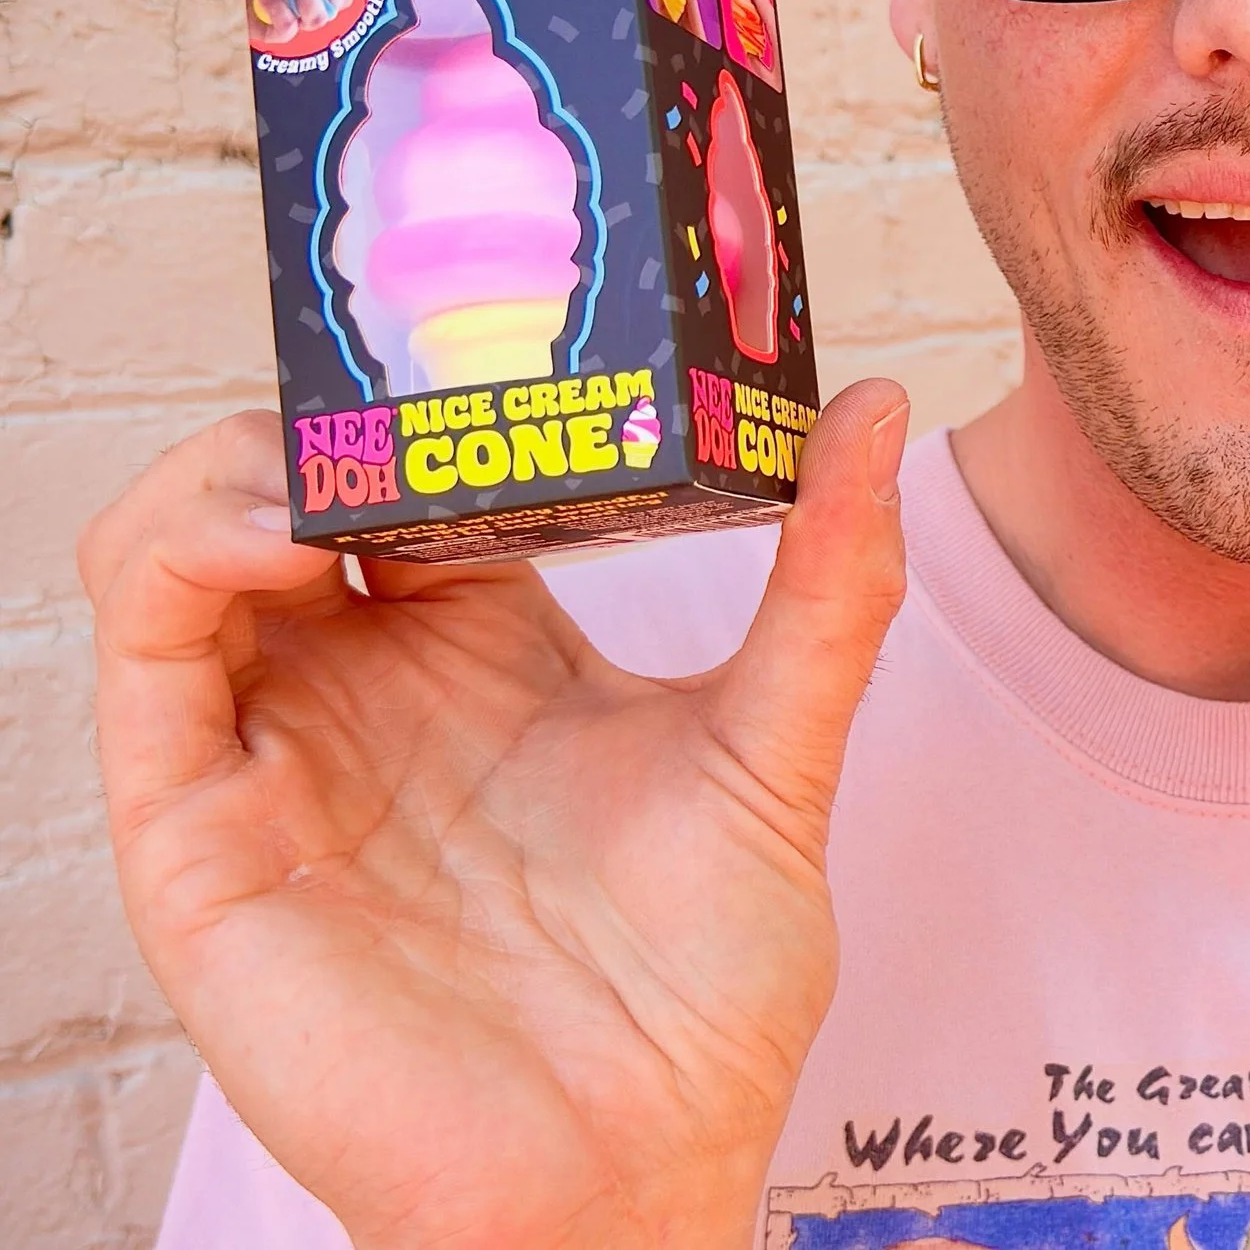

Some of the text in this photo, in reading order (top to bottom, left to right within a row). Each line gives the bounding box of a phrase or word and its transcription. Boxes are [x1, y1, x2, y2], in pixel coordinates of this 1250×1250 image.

[257, 51, 330, 74] Creamy
[400, 369, 655, 437] NICE CREAM
[689, 367, 734, 431] NEE
[734, 382, 771, 422] NICE
[294, 407, 393, 465] NEE
[405, 413, 619, 494] CONE
[694, 408, 737, 470] DOH
[738, 418, 806, 482] CON
[300, 455, 401, 513] DOH
[1044, 1063, 1116, 1103] The
[844, 1114, 1027, 1171] Where
[1051, 1108, 1160, 1164] You
